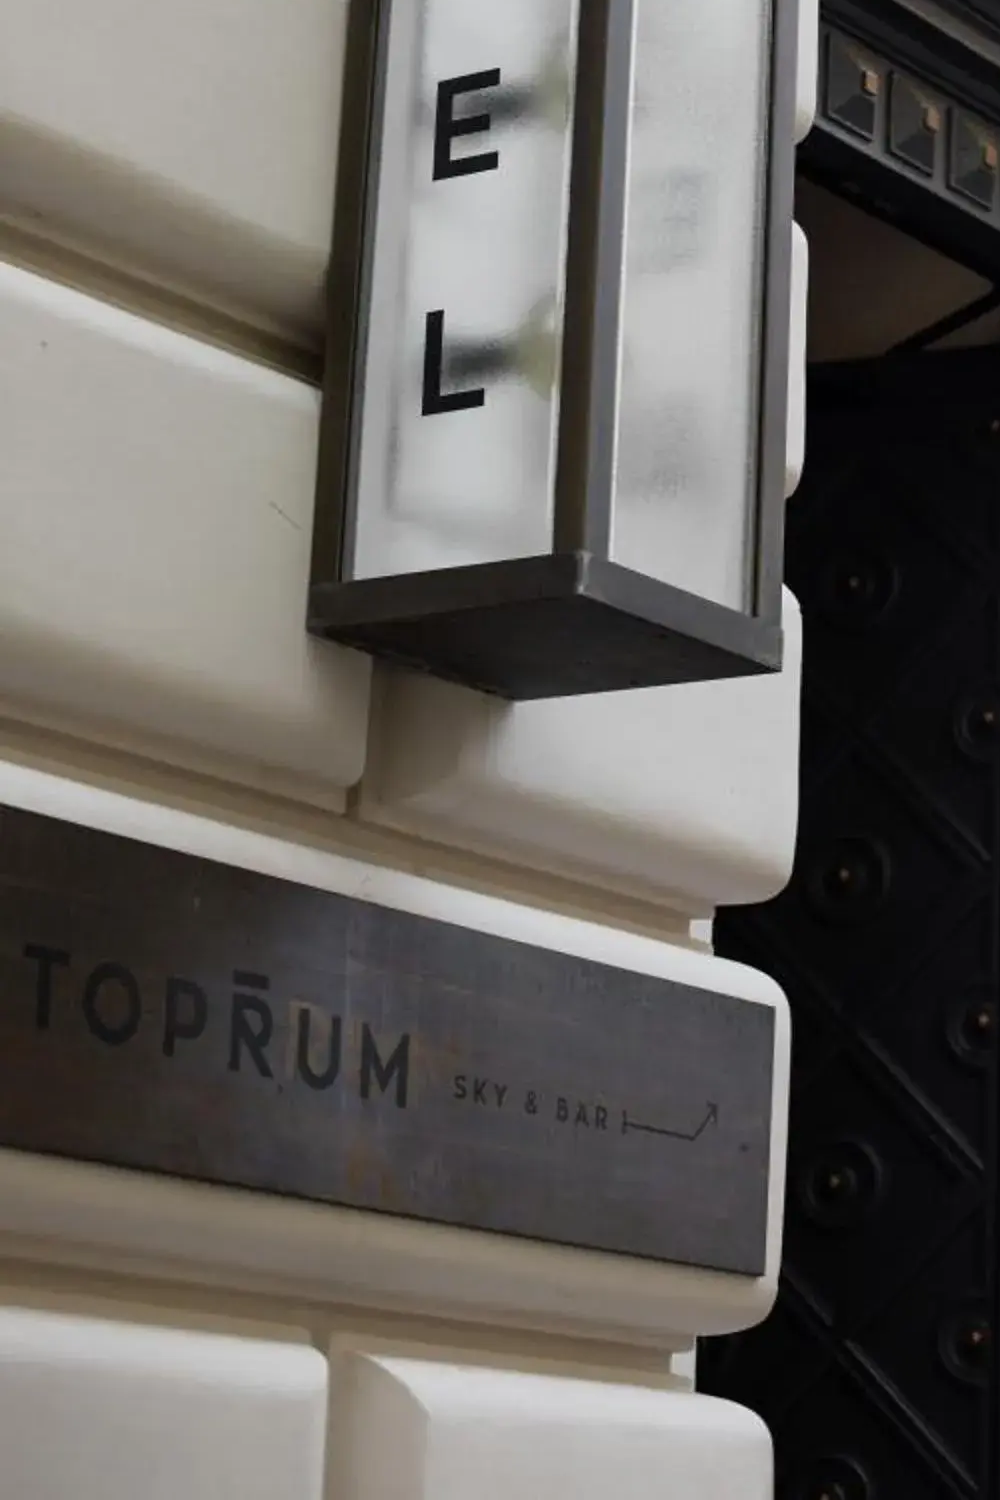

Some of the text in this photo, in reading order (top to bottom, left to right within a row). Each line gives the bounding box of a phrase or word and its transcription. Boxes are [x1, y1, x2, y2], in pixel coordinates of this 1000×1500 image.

[453, 1074, 508, 1108] SKY
[524, 1090, 539, 1116] &
[557, 1097, 609, 1131] BAR
